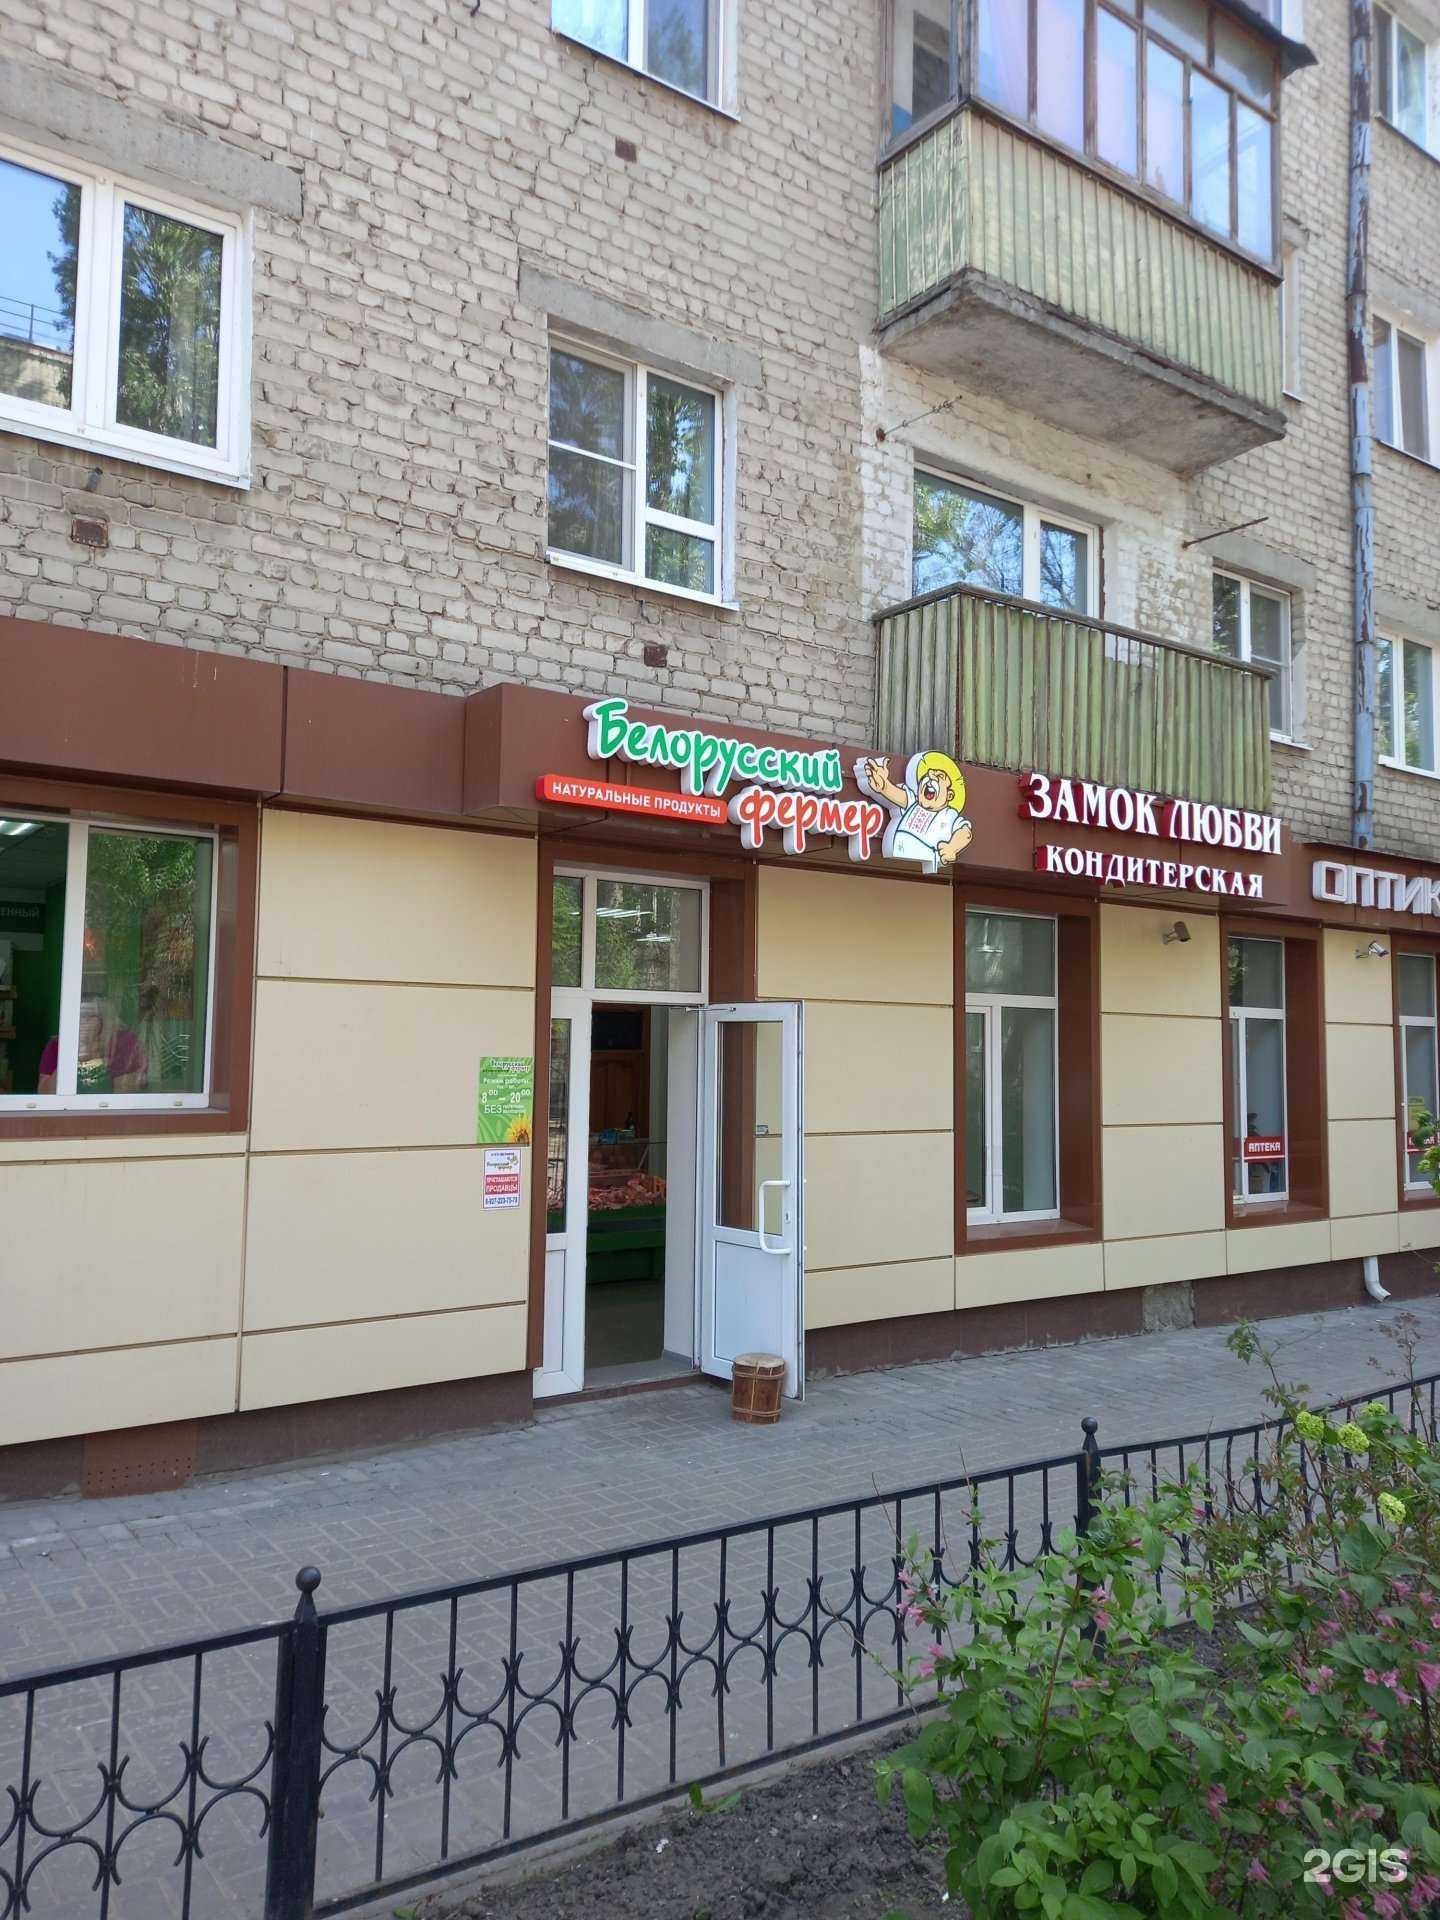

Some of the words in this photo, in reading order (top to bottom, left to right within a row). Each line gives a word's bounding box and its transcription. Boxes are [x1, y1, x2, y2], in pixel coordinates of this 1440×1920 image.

[590, 698, 842, 795] Белорусский
[552, 782, 651, 807] НАТУРАЛЬНЫЕ
[654, 797, 721, 818] ПРОДУКТЫ
[736, 786, 883, 861] фермер
[1027, 773, 1159, 837] ЗАМОК
[1168, 799, 1282, 855] ЛЮБВИ
[1044, 845, 1264, 899] КОНДИТЕРСКАЯ
[484, 1104, 502, 1114] БЕЗ
[1248, 1142, 1281, 1153] АПТЕКА
